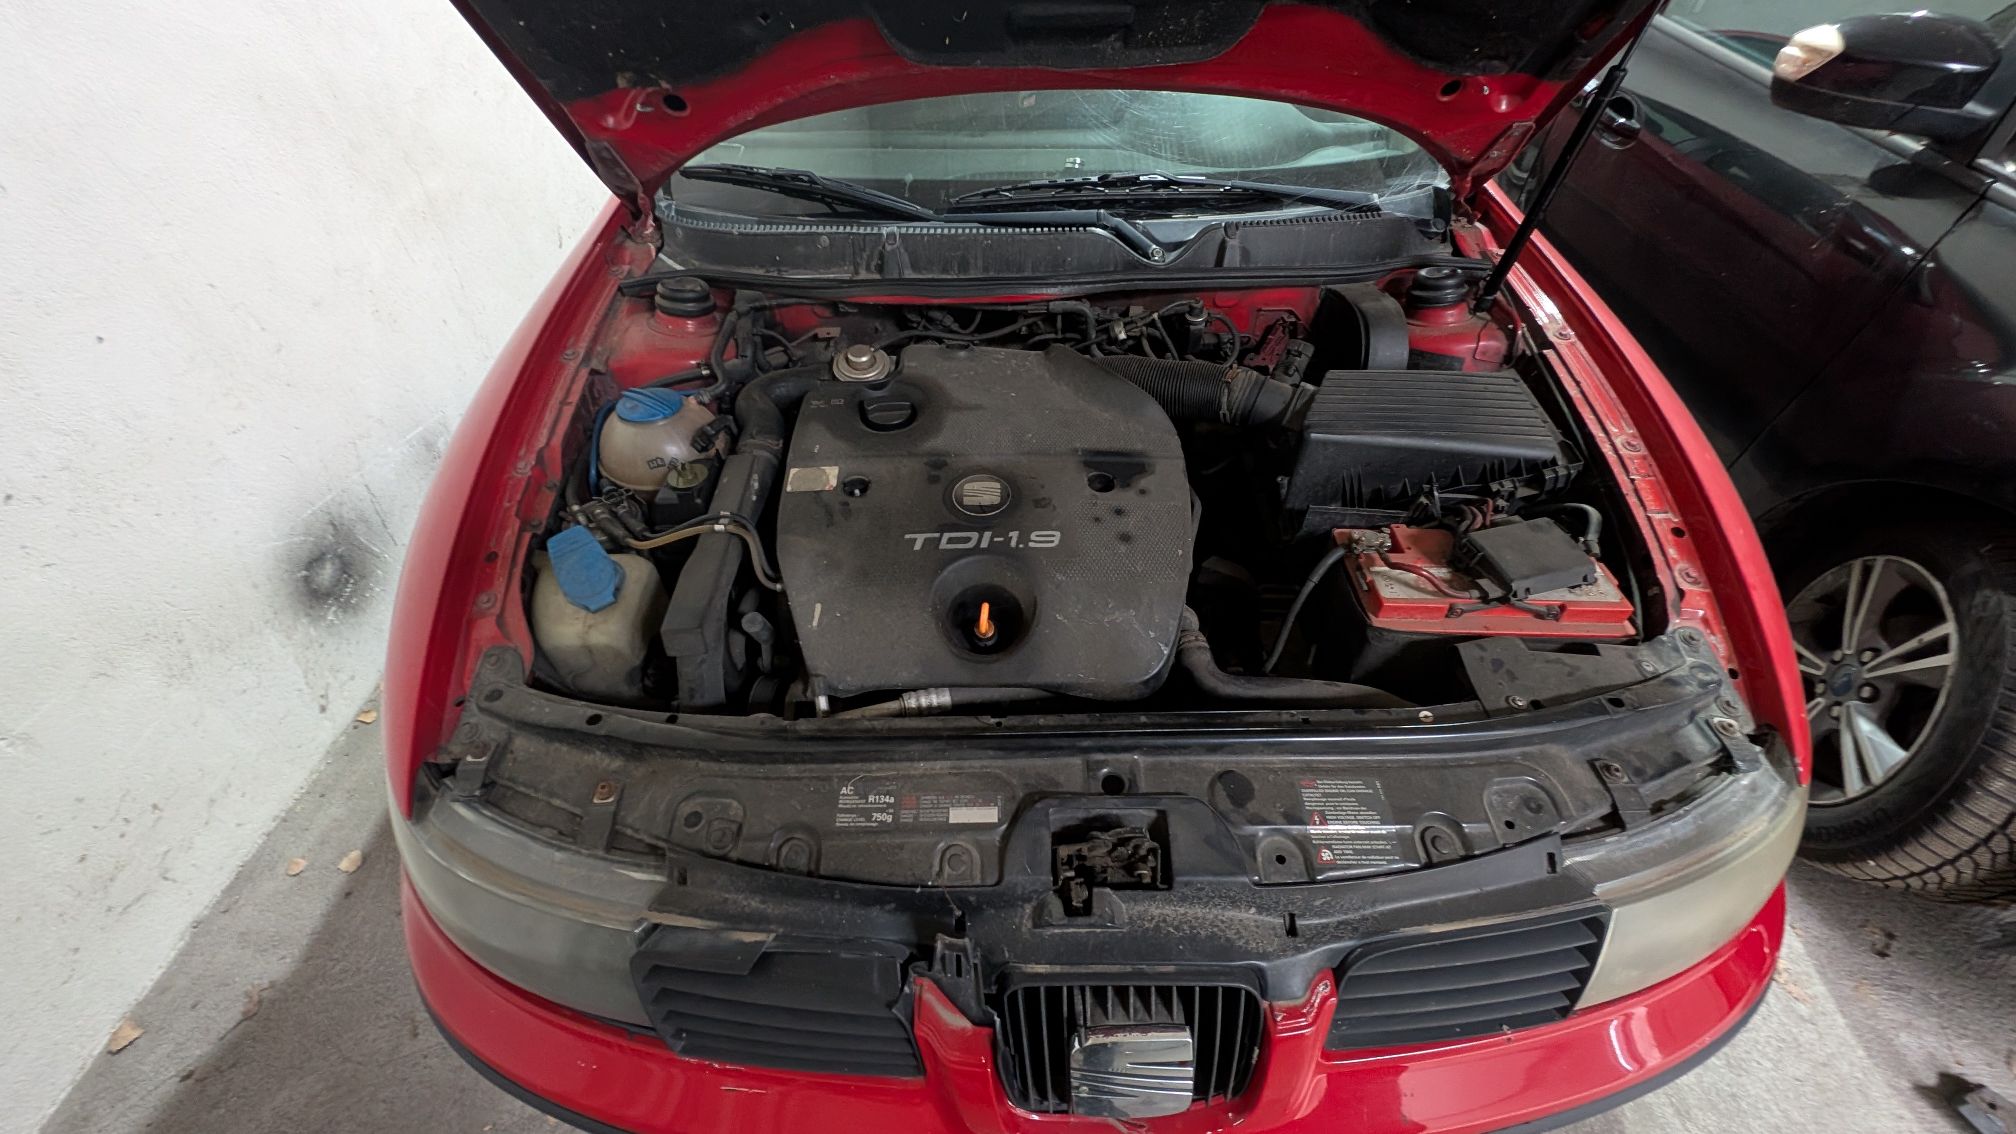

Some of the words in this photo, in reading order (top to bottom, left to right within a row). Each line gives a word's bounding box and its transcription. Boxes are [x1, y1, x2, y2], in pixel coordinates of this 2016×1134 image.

[904, 530, 1061, 551] TDI-1.9
[840, 786, 854, 795] AC
[868, 795, 895, 804] R134a
[871, 812, 893, 823] 750g
